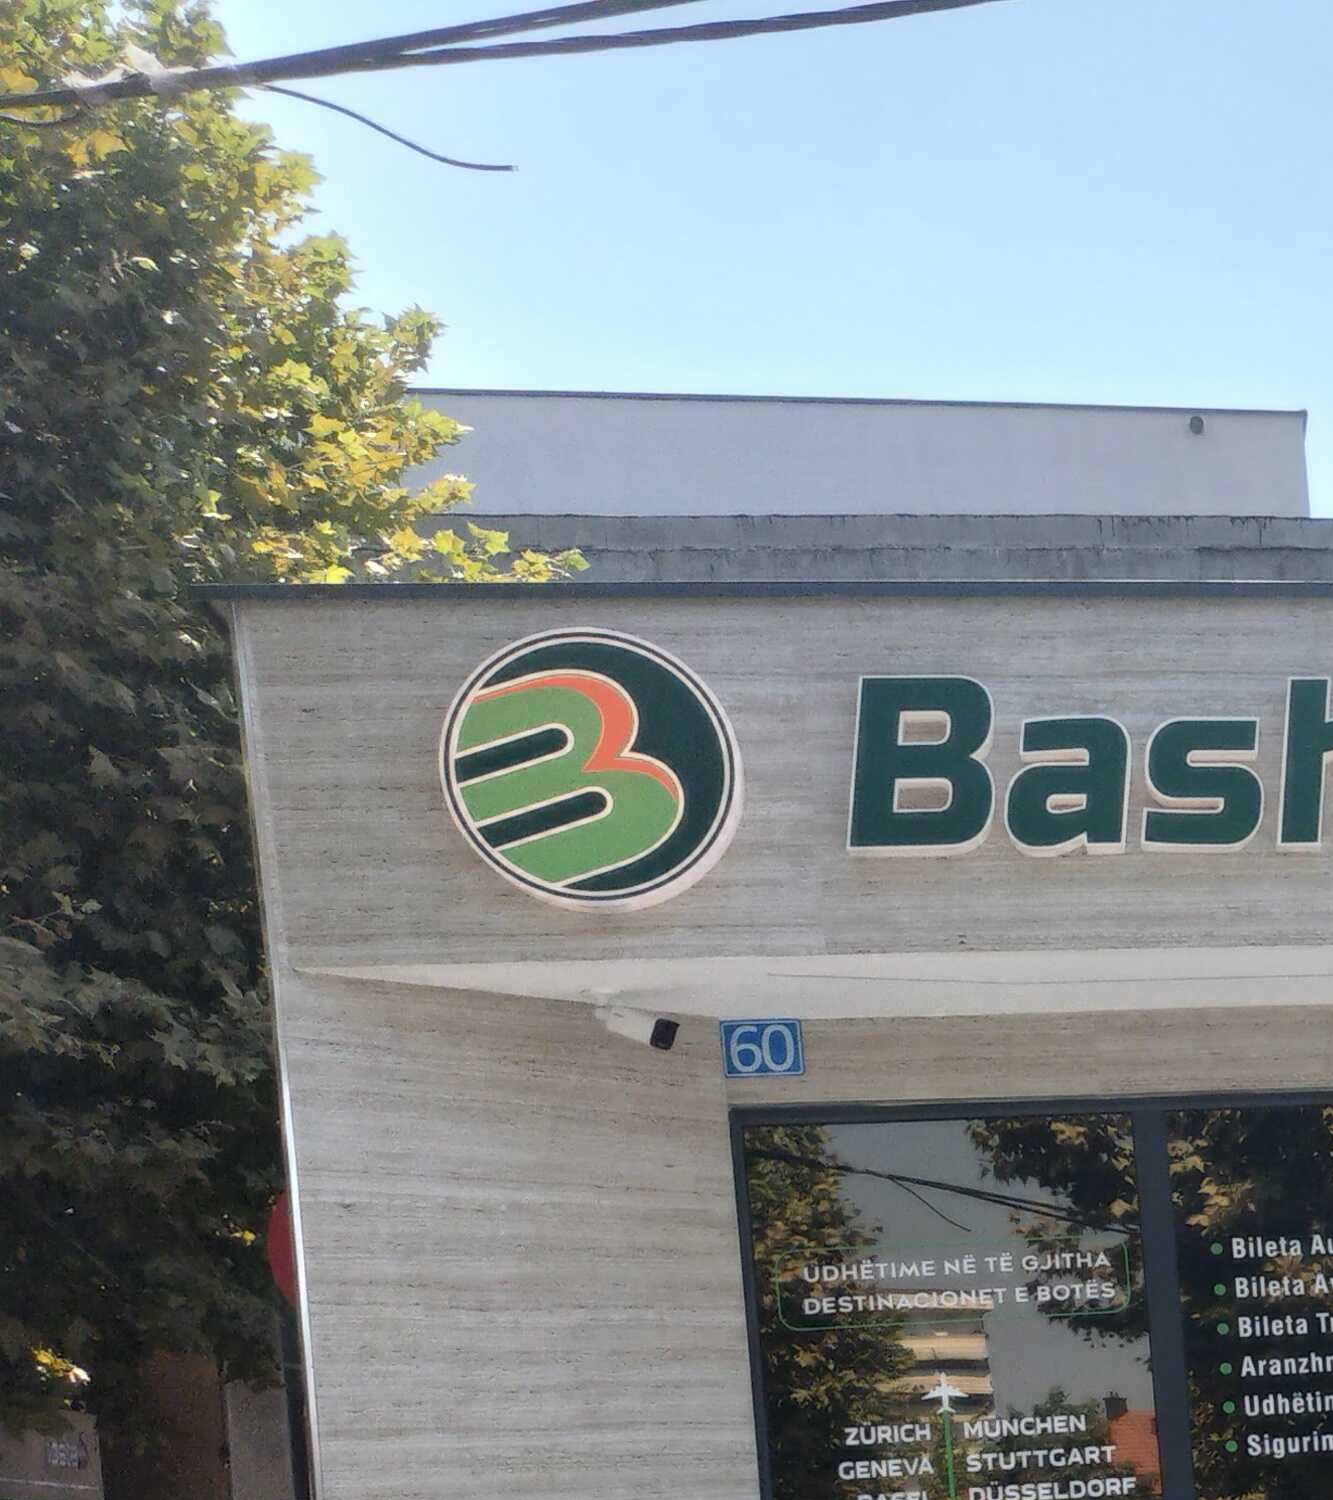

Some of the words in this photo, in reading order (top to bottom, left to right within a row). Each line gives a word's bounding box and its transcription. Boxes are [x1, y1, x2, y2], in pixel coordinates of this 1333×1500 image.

[730, 1025, 794, 1072] 60
[1232, 1237, 1300, 1259] Bileta
[803, 1259, 935, 1283] UDHËTIME
[944, 1254, 976, 1275] NË
[985, 1252, 1014, 1272] TË
[1022, 1251, 1111, 1272] GJITHA
[803, 1288, 1007, 1315] DESTINACIONET
[1015, 1287, 1028, 1302] E
[1037, 1279, 1116, 1301] BOTËS
[1235, 1277, 1304, 1298] Bileta
[1238, 1316, 1308, 1337] Bileta
[845, 1423, 931, 1446] ZÜRICH
[963, 1414, 1087, 1439] MÜNCHEN
[839, 1457, 934, 1480] GENEVA
[966, 1446, 1116, 1472] STUTTGART
